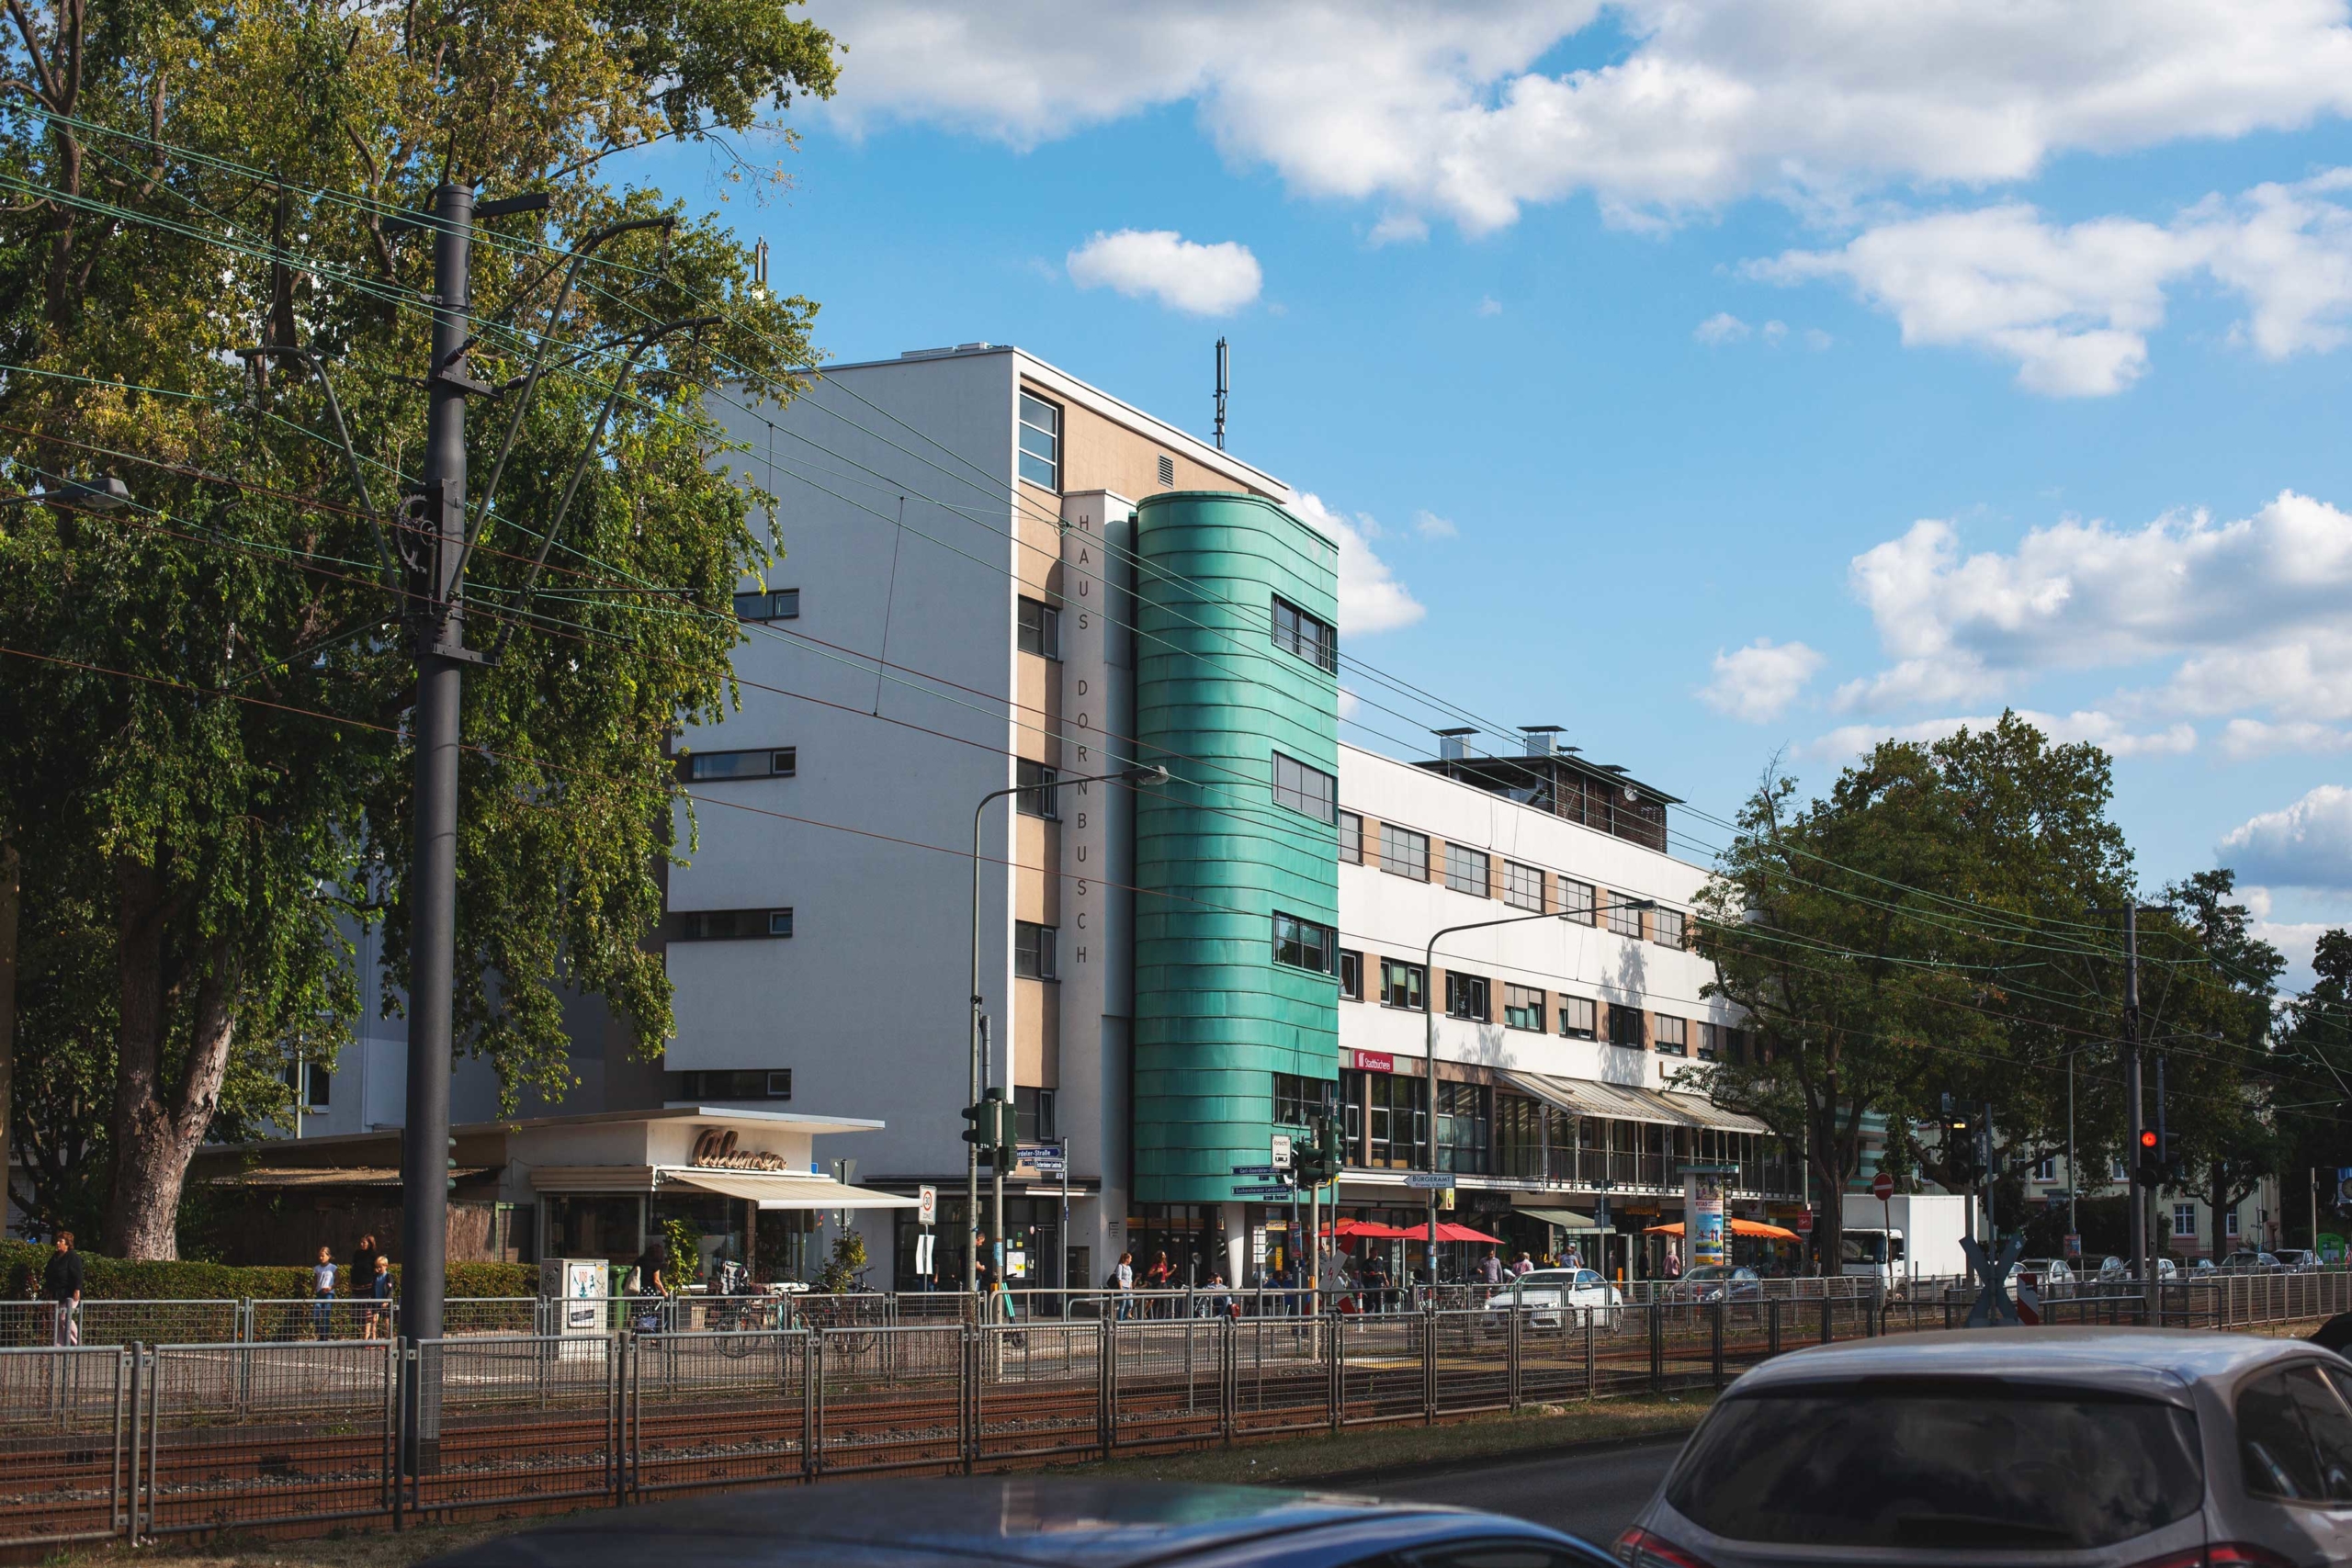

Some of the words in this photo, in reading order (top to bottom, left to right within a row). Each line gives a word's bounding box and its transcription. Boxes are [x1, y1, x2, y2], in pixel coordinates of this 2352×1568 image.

[1079, 515, 1090, 630] HAUS
[1077, 680, 1088, 964] DORNBUSCH
[1364, 1057, 1391, 1070] Stadtbücherei
[925, 1196, 931, 1205] 30
